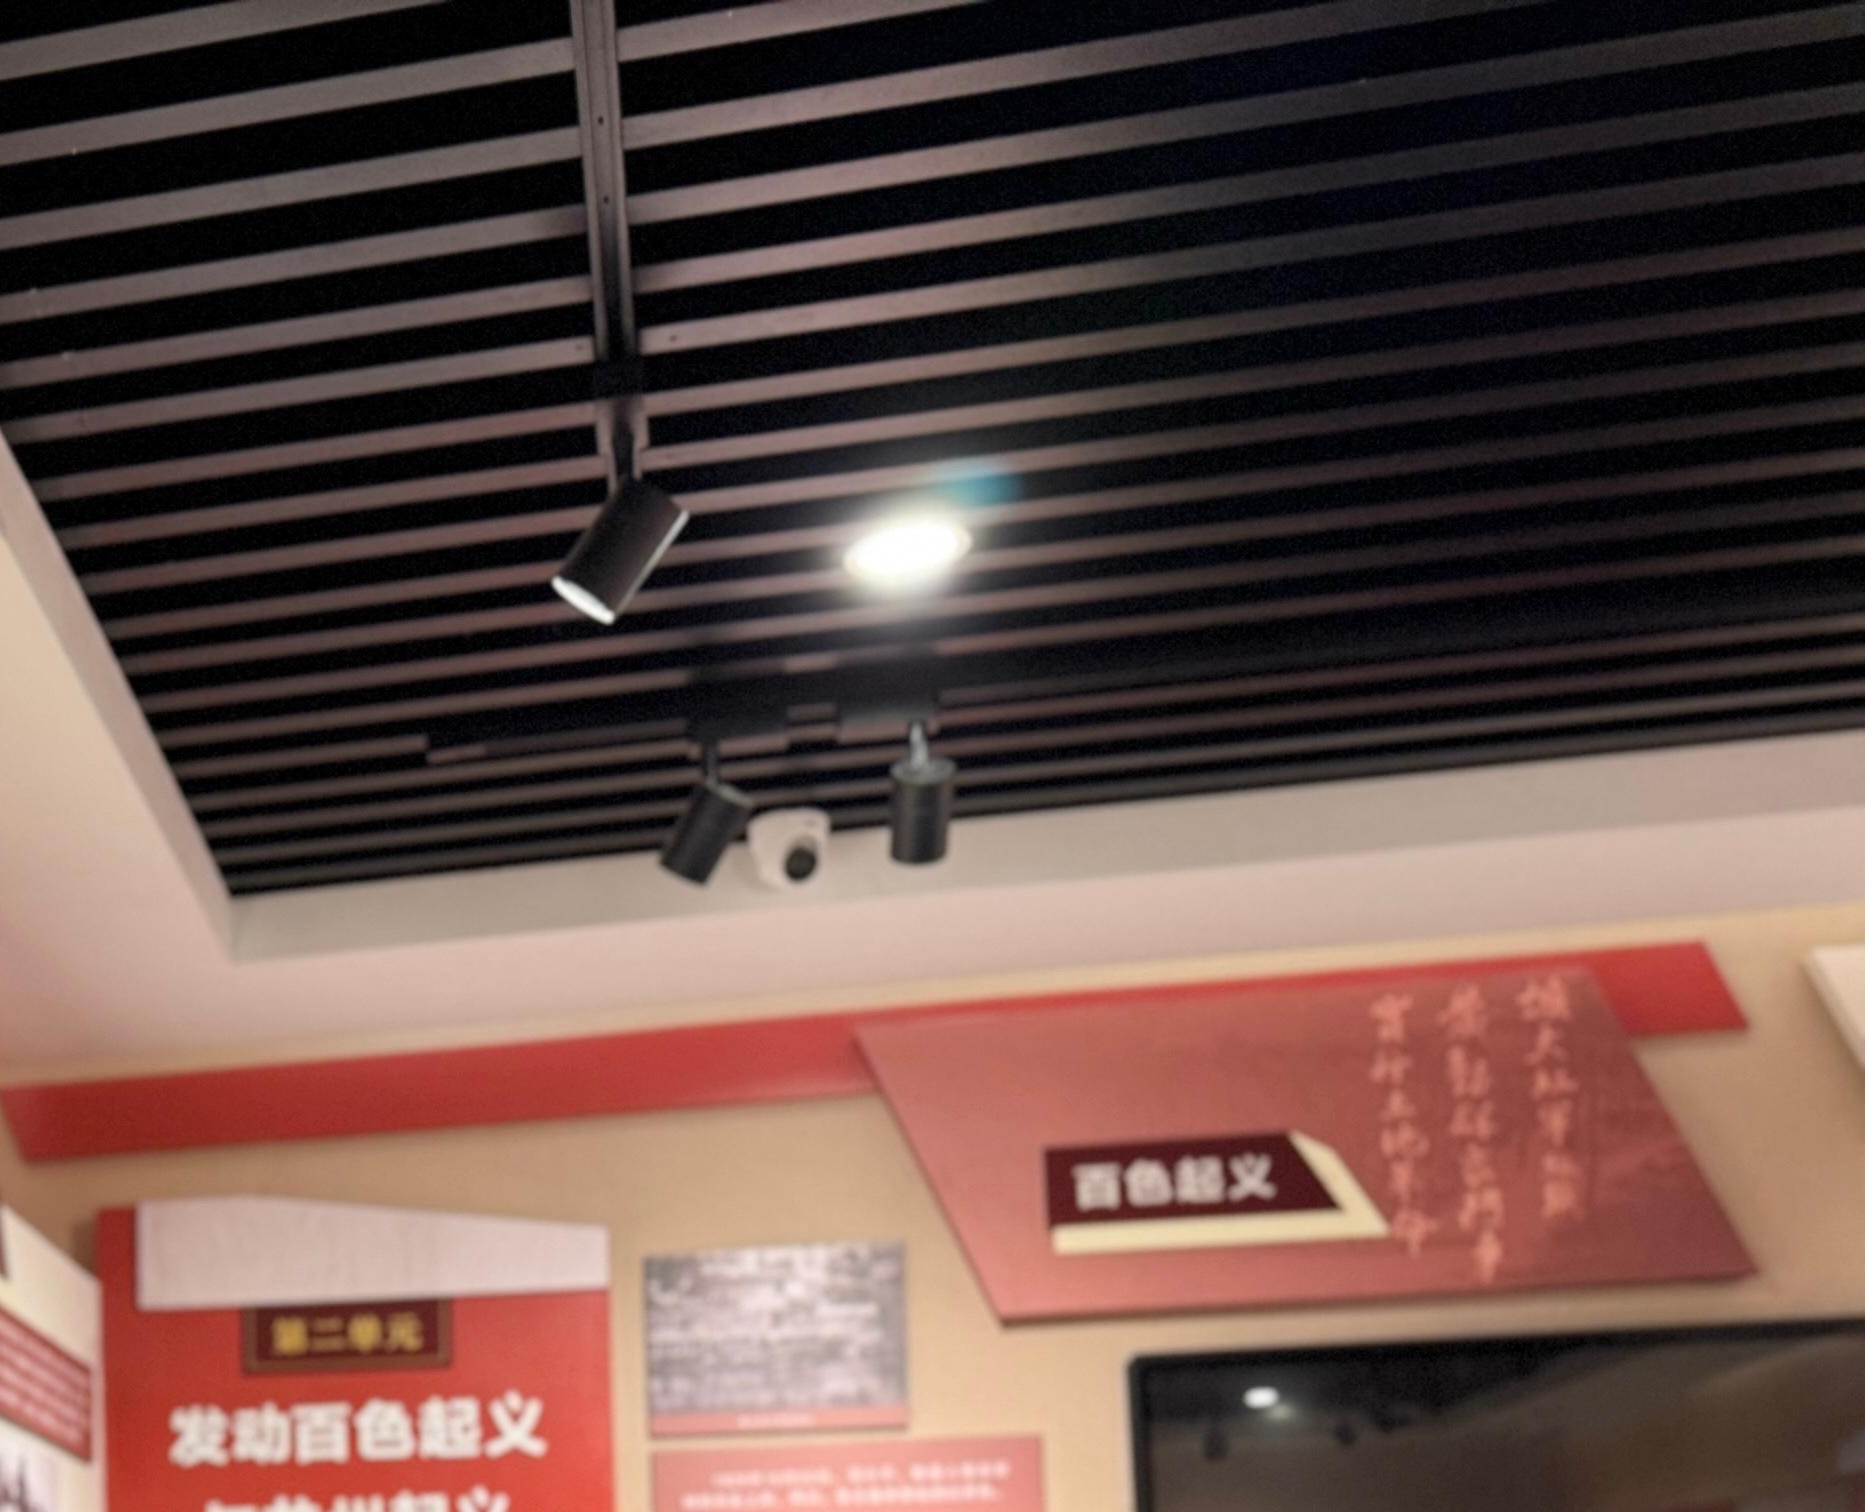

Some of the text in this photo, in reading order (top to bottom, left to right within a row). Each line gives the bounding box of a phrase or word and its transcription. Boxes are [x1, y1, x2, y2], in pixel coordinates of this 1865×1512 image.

[1070, 1152, 1279, 1213] 百色起义
[168, 1387, 547, 1469] 发动百色起义
